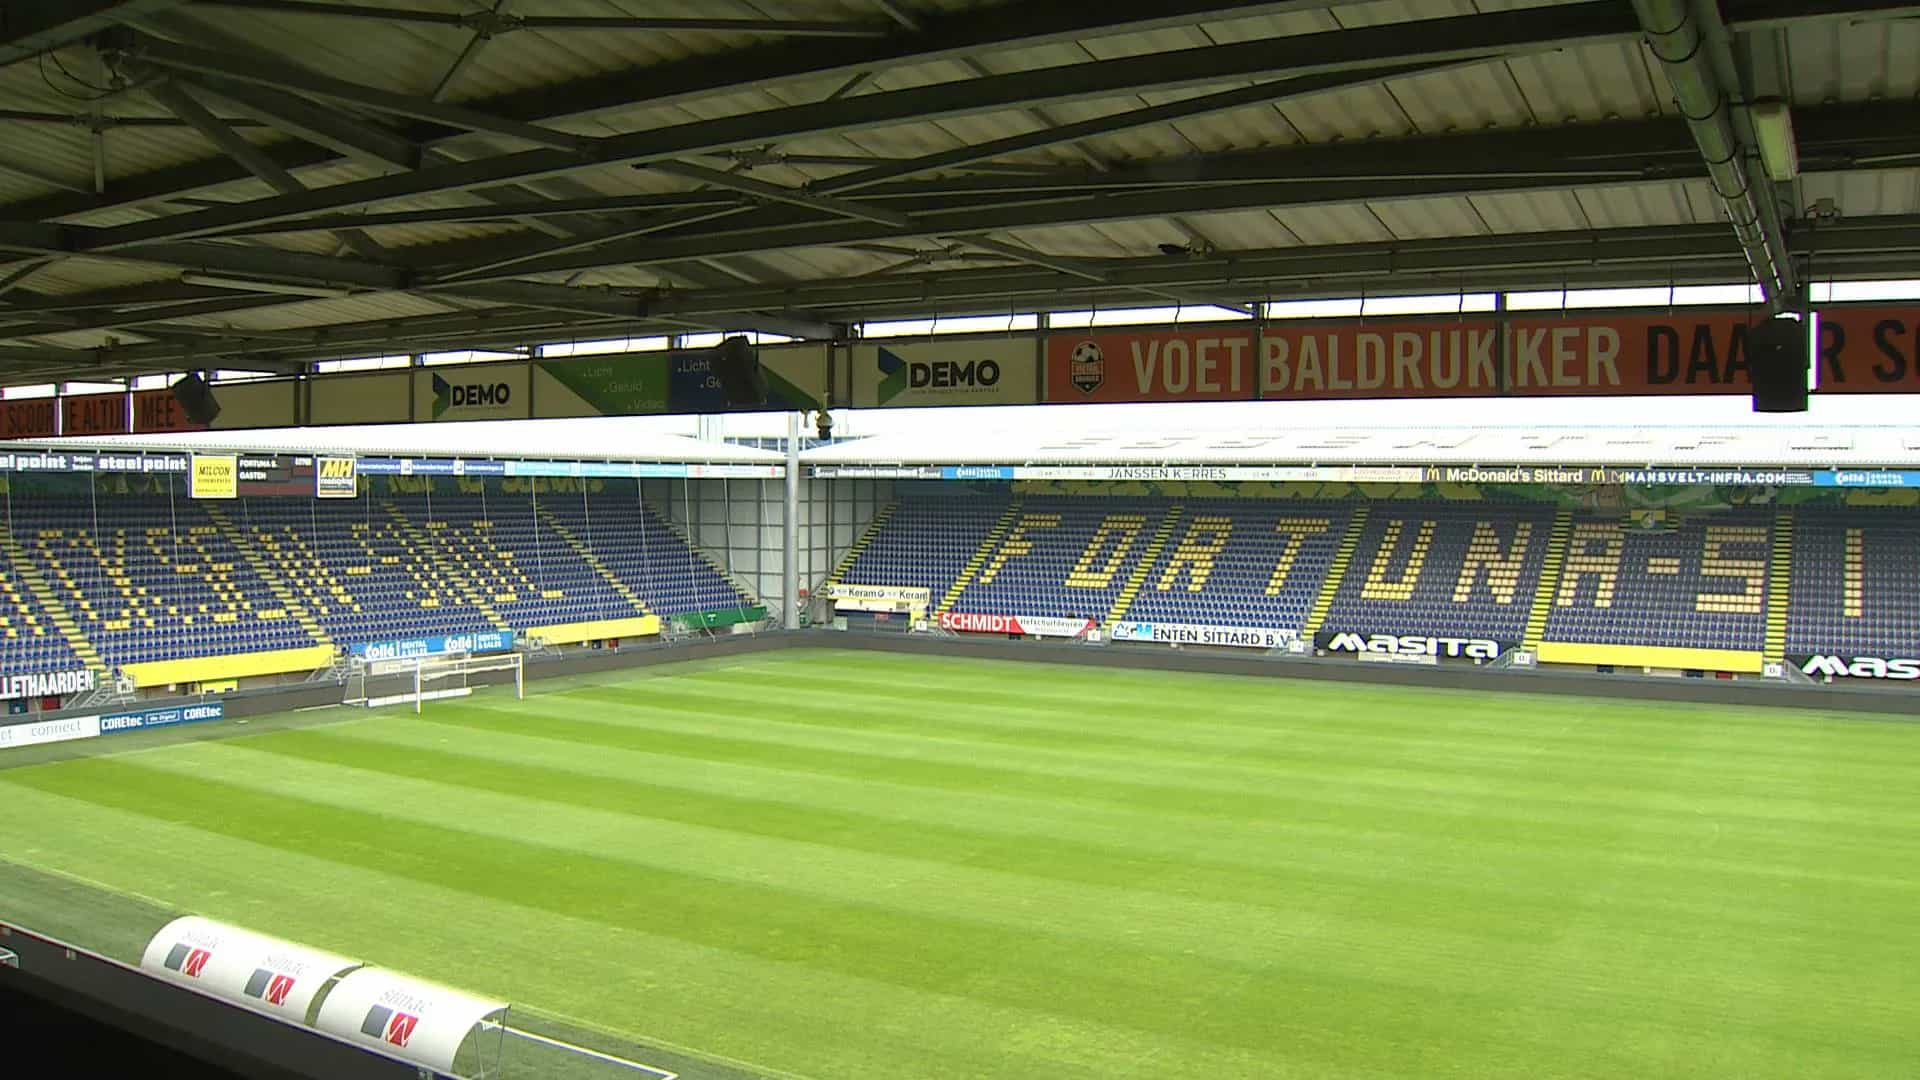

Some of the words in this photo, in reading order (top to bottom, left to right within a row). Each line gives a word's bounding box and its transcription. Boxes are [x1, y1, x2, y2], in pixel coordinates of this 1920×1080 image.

[1872, 319, 1920, 383] S
[909, 359, 1001, 388] DEMO
[452, 382, 510, 406] DEMO
[1108, 467, 1168, 479] JANSSEN
[1446, 468, 1530, 483] McDonald's
[1534, 468, 1583, 483] Sittard
[1625, 471, 1785, 484] MANSVELT-INFRA.COM
[943, 613, 1015, 632] SCHMIDT
[1203, 629, 1261, 645] SITTARD
